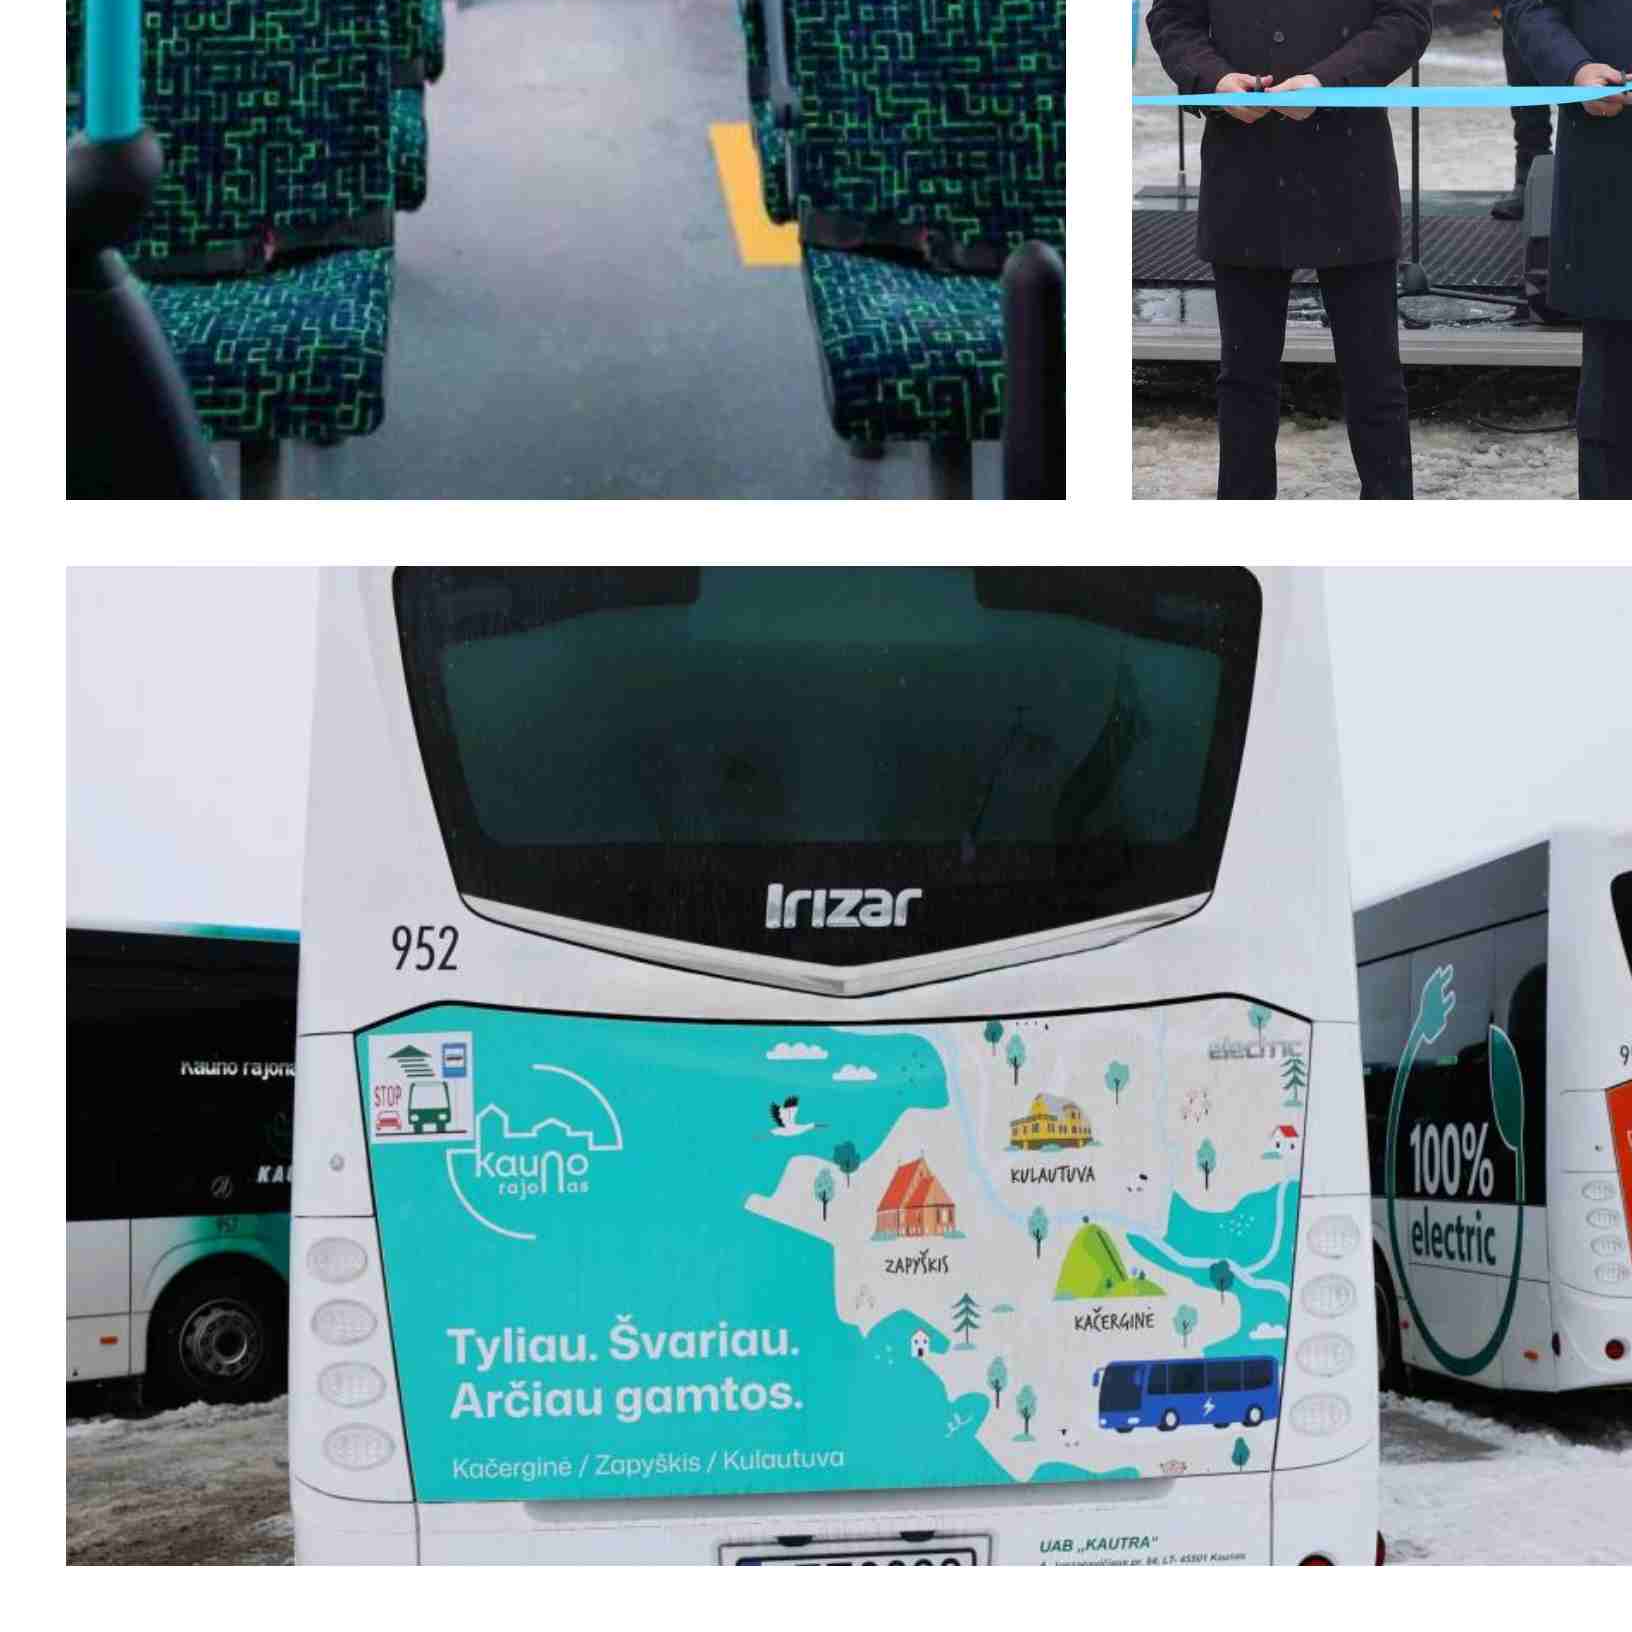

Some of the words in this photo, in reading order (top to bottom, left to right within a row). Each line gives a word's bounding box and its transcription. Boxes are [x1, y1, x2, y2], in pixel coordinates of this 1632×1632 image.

[765, 882, 923, 930] Irizar
[391, 924, 460, 971] 952
[374, 1084, 401, 1108] STOP
[1010, 1164, 1097, 1184] KULAUTUVA
[1409, 1121, 1495, 1198] 100%
[1411, 1205, 1497, 1266] electric
[885, 1248, 950, 1274] ZAPYŠKIS
[1073, 1306, 1156, 1331] KAČERGINĖ
[446, 1326, 599, 1373] Tyliau.
[608, 1313, 801, 1362] Švariau.
[449, 1378, 602, 1421] Arčiau
[614, 1375, 806, 1424] gamtos.
[451, 1455, 573, 1482] Kačerginė
[594, 1450, 701, 1481] Zapyškis
[723, 1448, 847, 1472] Kulautuva
[1039, 1538, 1074, 1554] UAB
